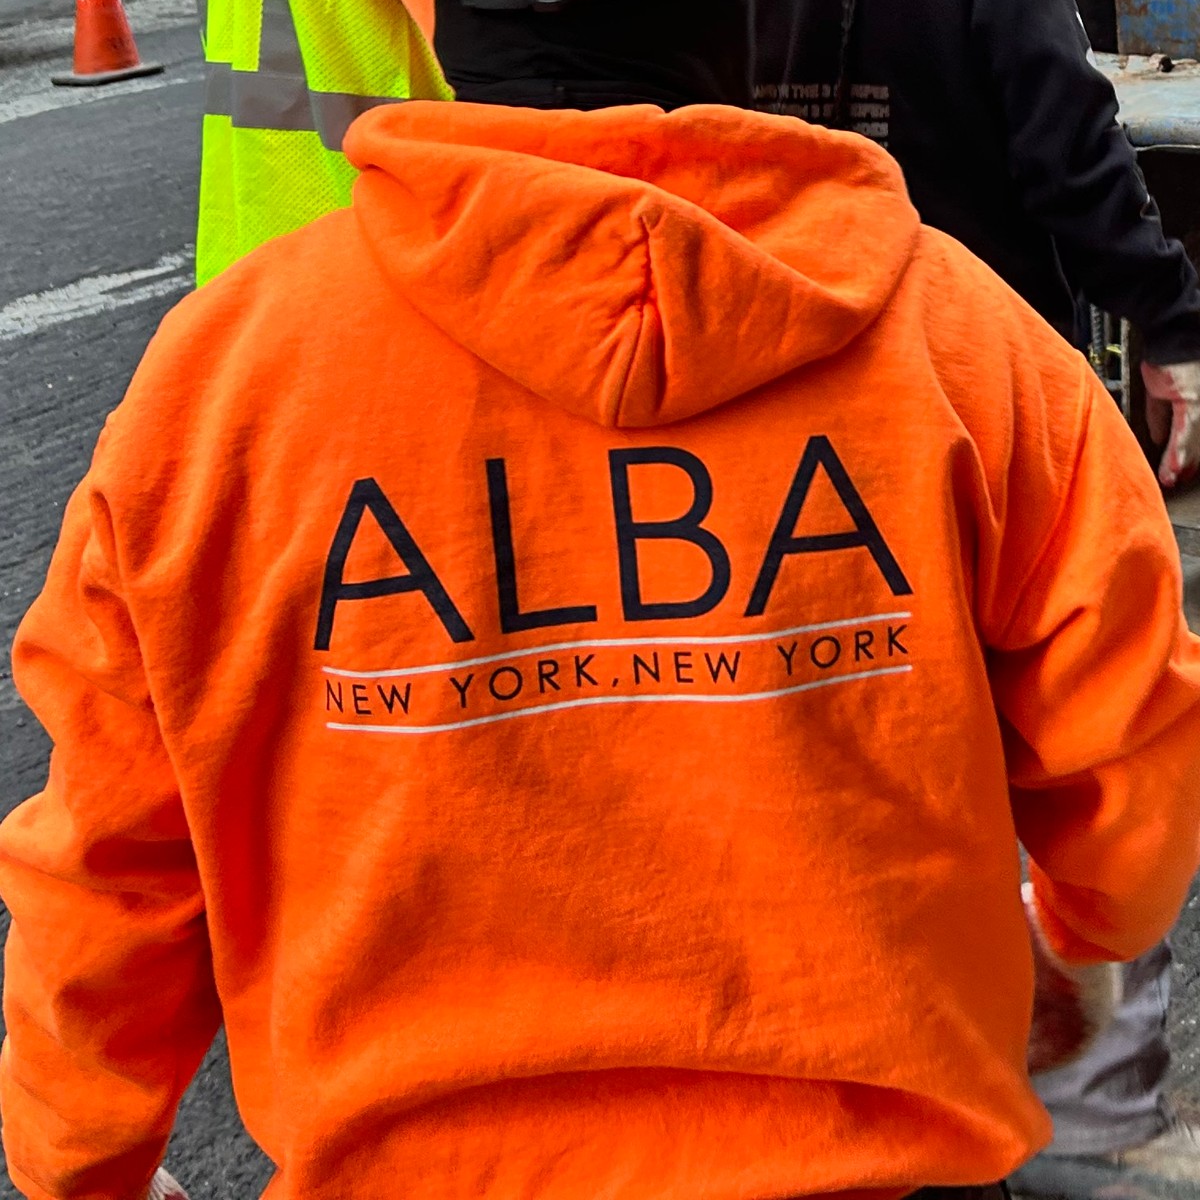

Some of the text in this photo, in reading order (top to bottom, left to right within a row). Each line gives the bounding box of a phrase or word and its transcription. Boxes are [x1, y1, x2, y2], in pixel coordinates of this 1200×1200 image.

[313, 434, 914, 652] ALBA
[325, 680, 412, 716] NEW
[777, 624, 911, 676] YORK
